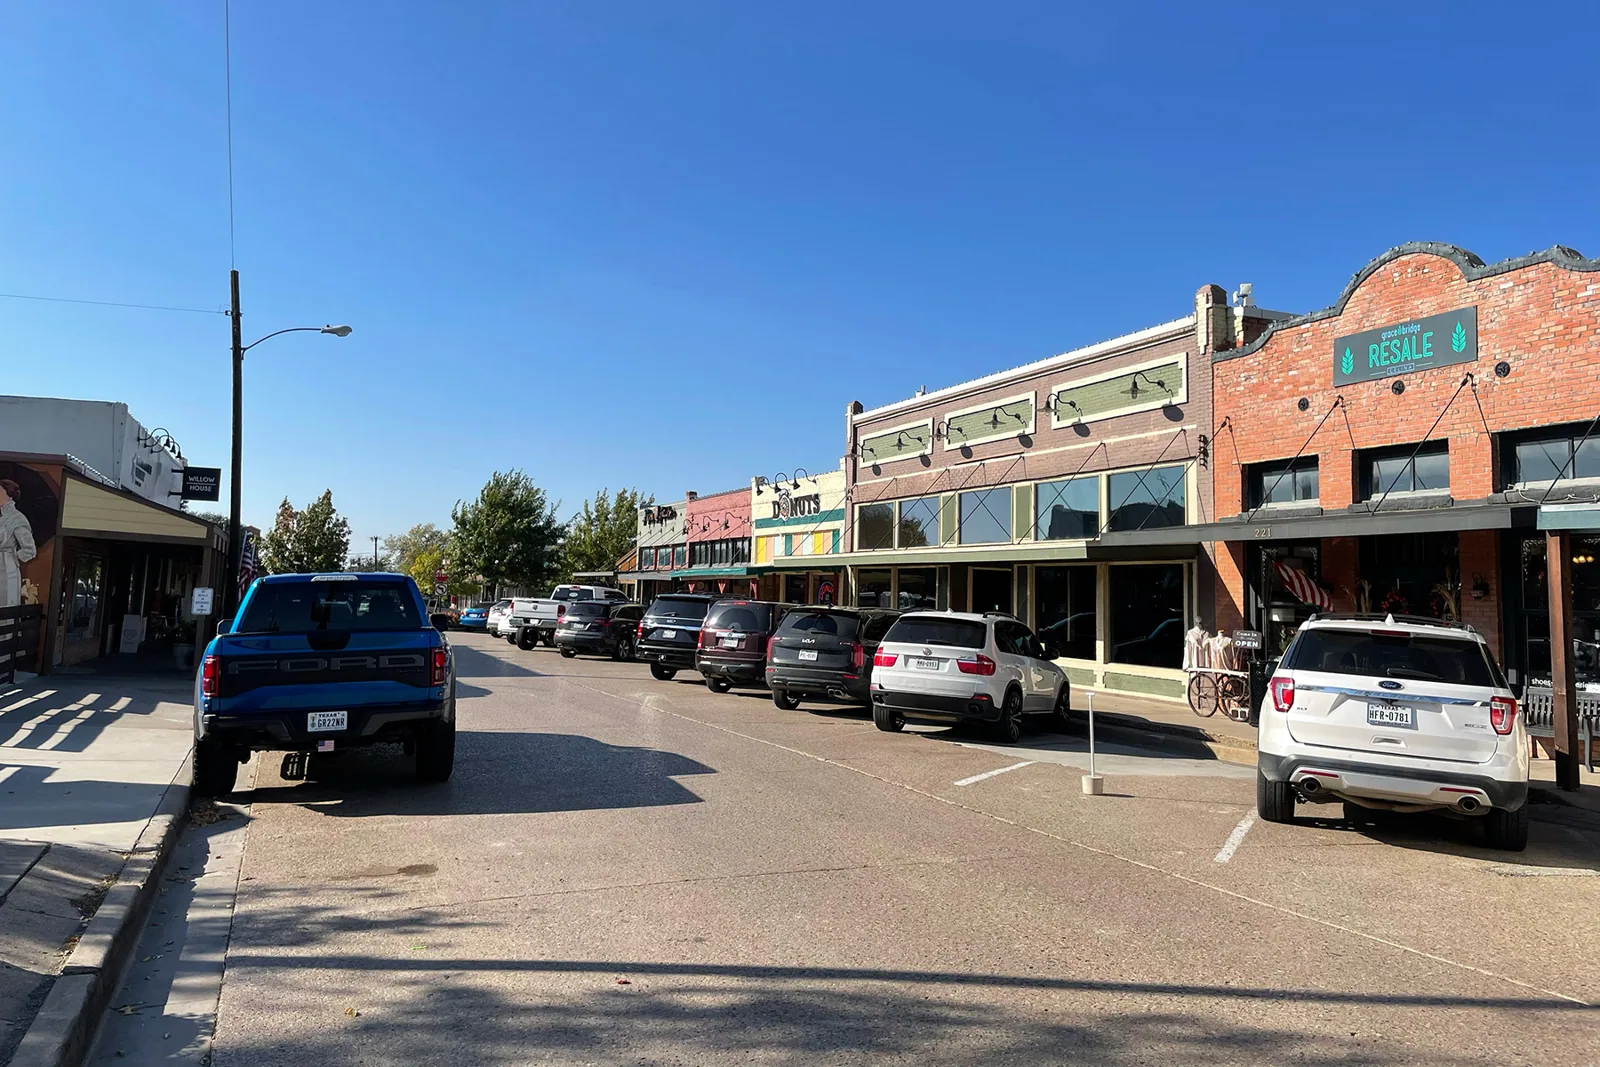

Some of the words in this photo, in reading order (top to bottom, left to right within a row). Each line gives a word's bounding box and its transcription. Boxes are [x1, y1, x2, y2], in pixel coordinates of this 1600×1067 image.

[1368, 331, 1433, 368] RESALE
[188, 475, 216, 483] WILLOW
[772, 493, 820, 519] DONUTS
[1254, 527, 1272, 538] 221
[1235, 640, 1259, 648] OPEN
[228, 654, 425, 675] FORD
